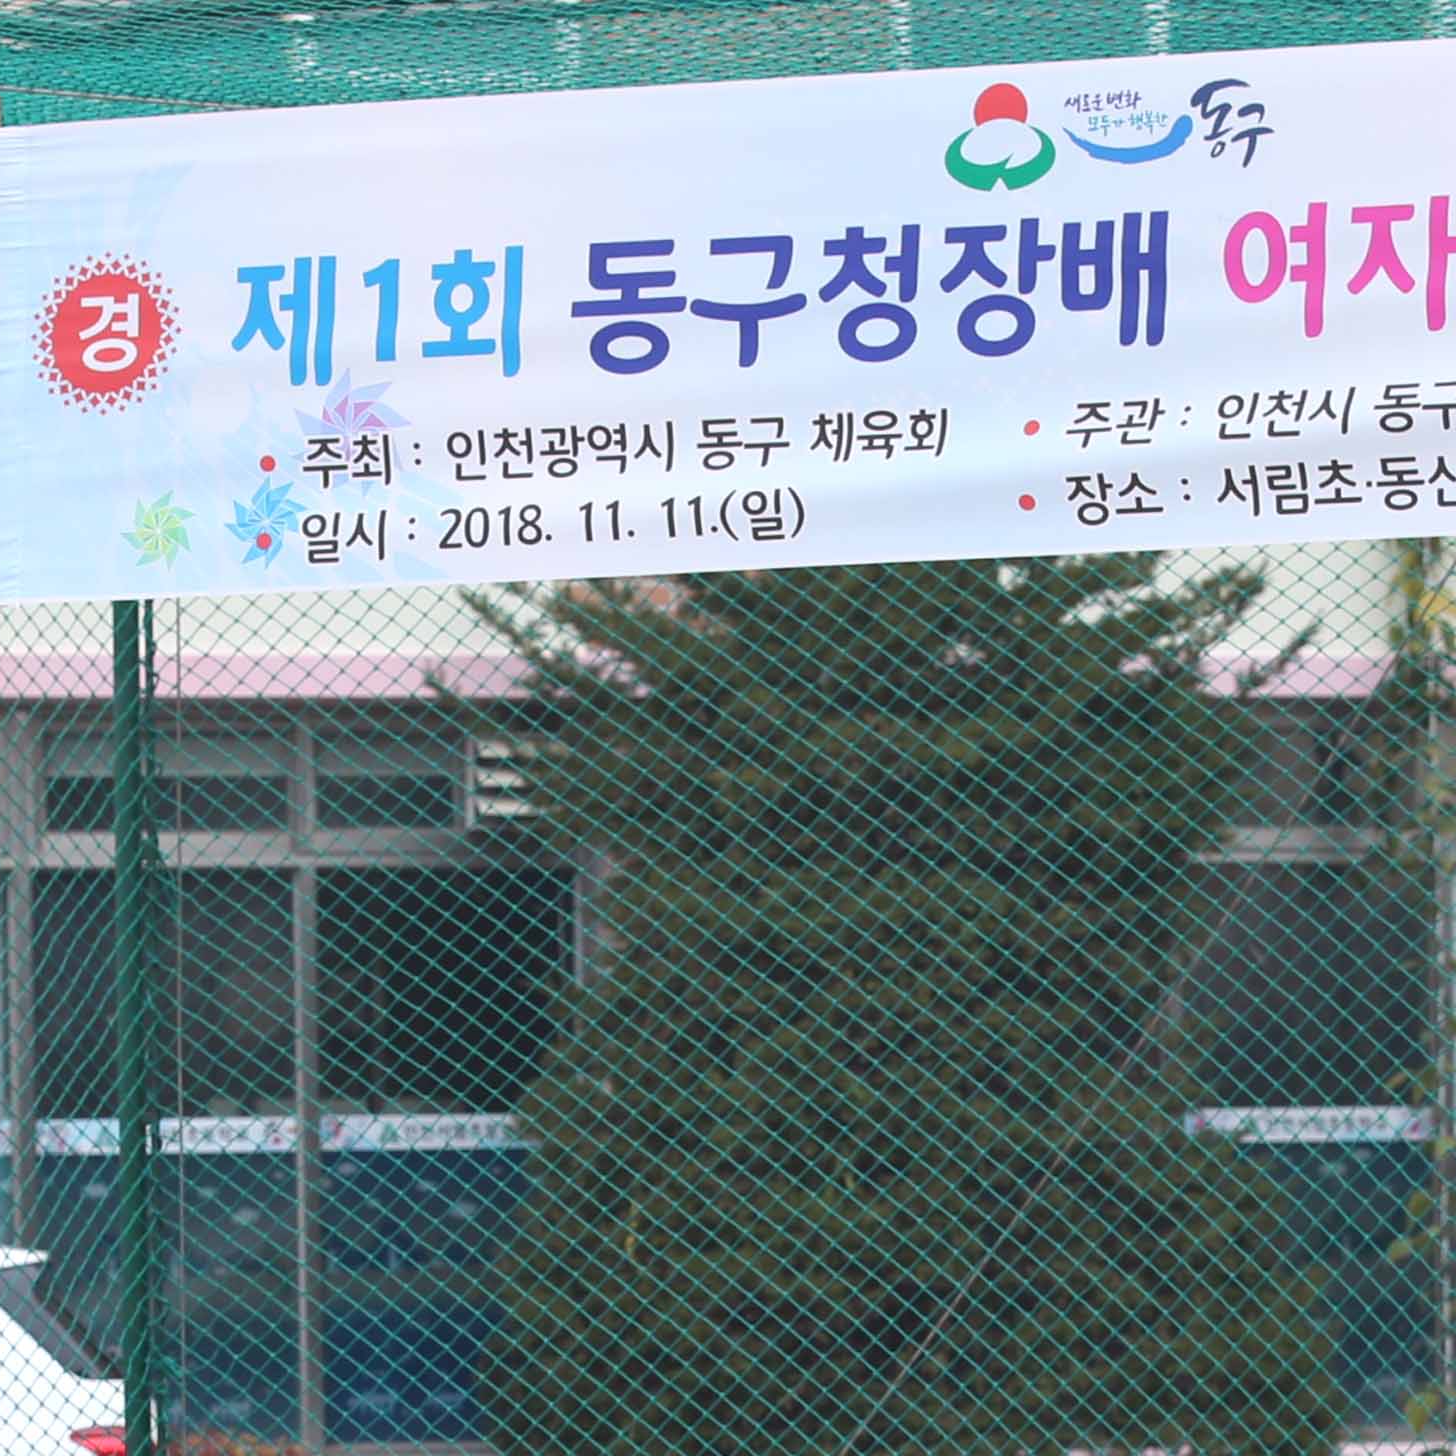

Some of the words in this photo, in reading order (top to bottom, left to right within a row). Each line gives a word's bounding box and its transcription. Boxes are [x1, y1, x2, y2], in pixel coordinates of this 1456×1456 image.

[1190, 77, 1275, 169] 동구
[78, 292, 140, 372] 경
[230, 244, 525, 388] 제1회
[570, 209, 1170, 376] 동구청장배
[302, 434, 391, 489] 주최
[446, 420, 674, 482] 인천광역시
[696, 416, 790, 471] 동구
[810, 407, 948, 462] 체육회
[1066, 397, 1166, 449] 주관
[1217, 386, 1356, 440] 인천시
[302, 509, 388, 564] 일시
[439, 504, 553, 550] 2018.
[579, 500, 635, 542] 11.
[661, 487, 805, 542] 11.(일)
[1065, 472, 1164, 526] 장소
